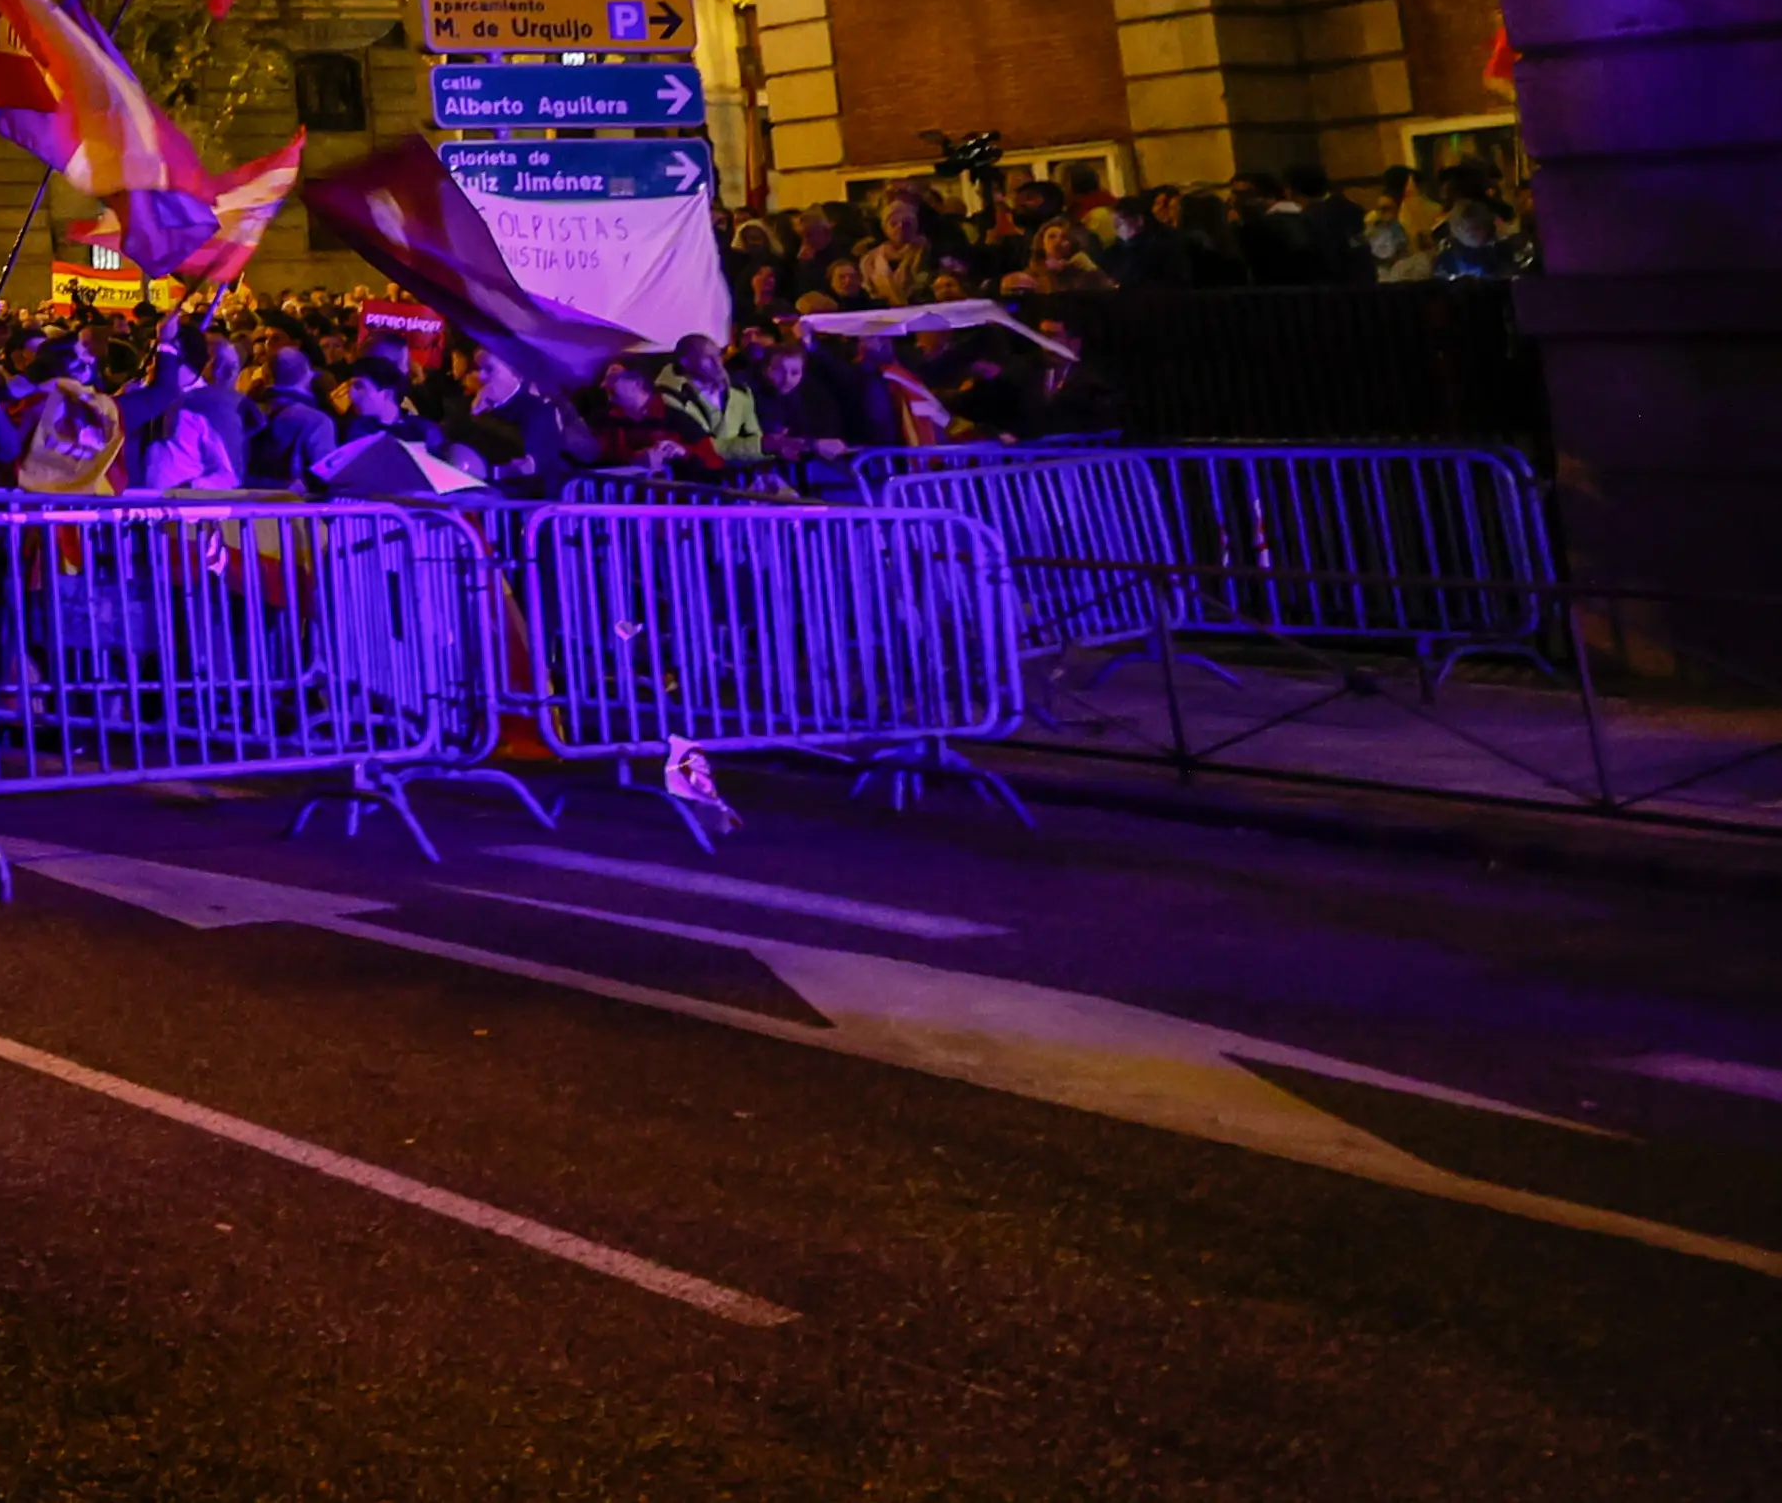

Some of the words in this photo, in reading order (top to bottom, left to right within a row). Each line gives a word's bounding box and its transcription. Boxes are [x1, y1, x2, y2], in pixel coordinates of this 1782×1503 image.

[433, 0, 545, 13] aparcamiento
[434, 18, 461, 38] M.
[473, 19, 498, 38] de
[511, 18, 593, 42] Urquijo
[441, 76, 483, 91] calle
[445, 96, 524, 116] Alberto
[538, 96, 629, 119] Aguilera
[448, 150, 518, 167] glorieta
[527, 150, 551, 166] de
[513, 170, 605, 193] Jiménez
